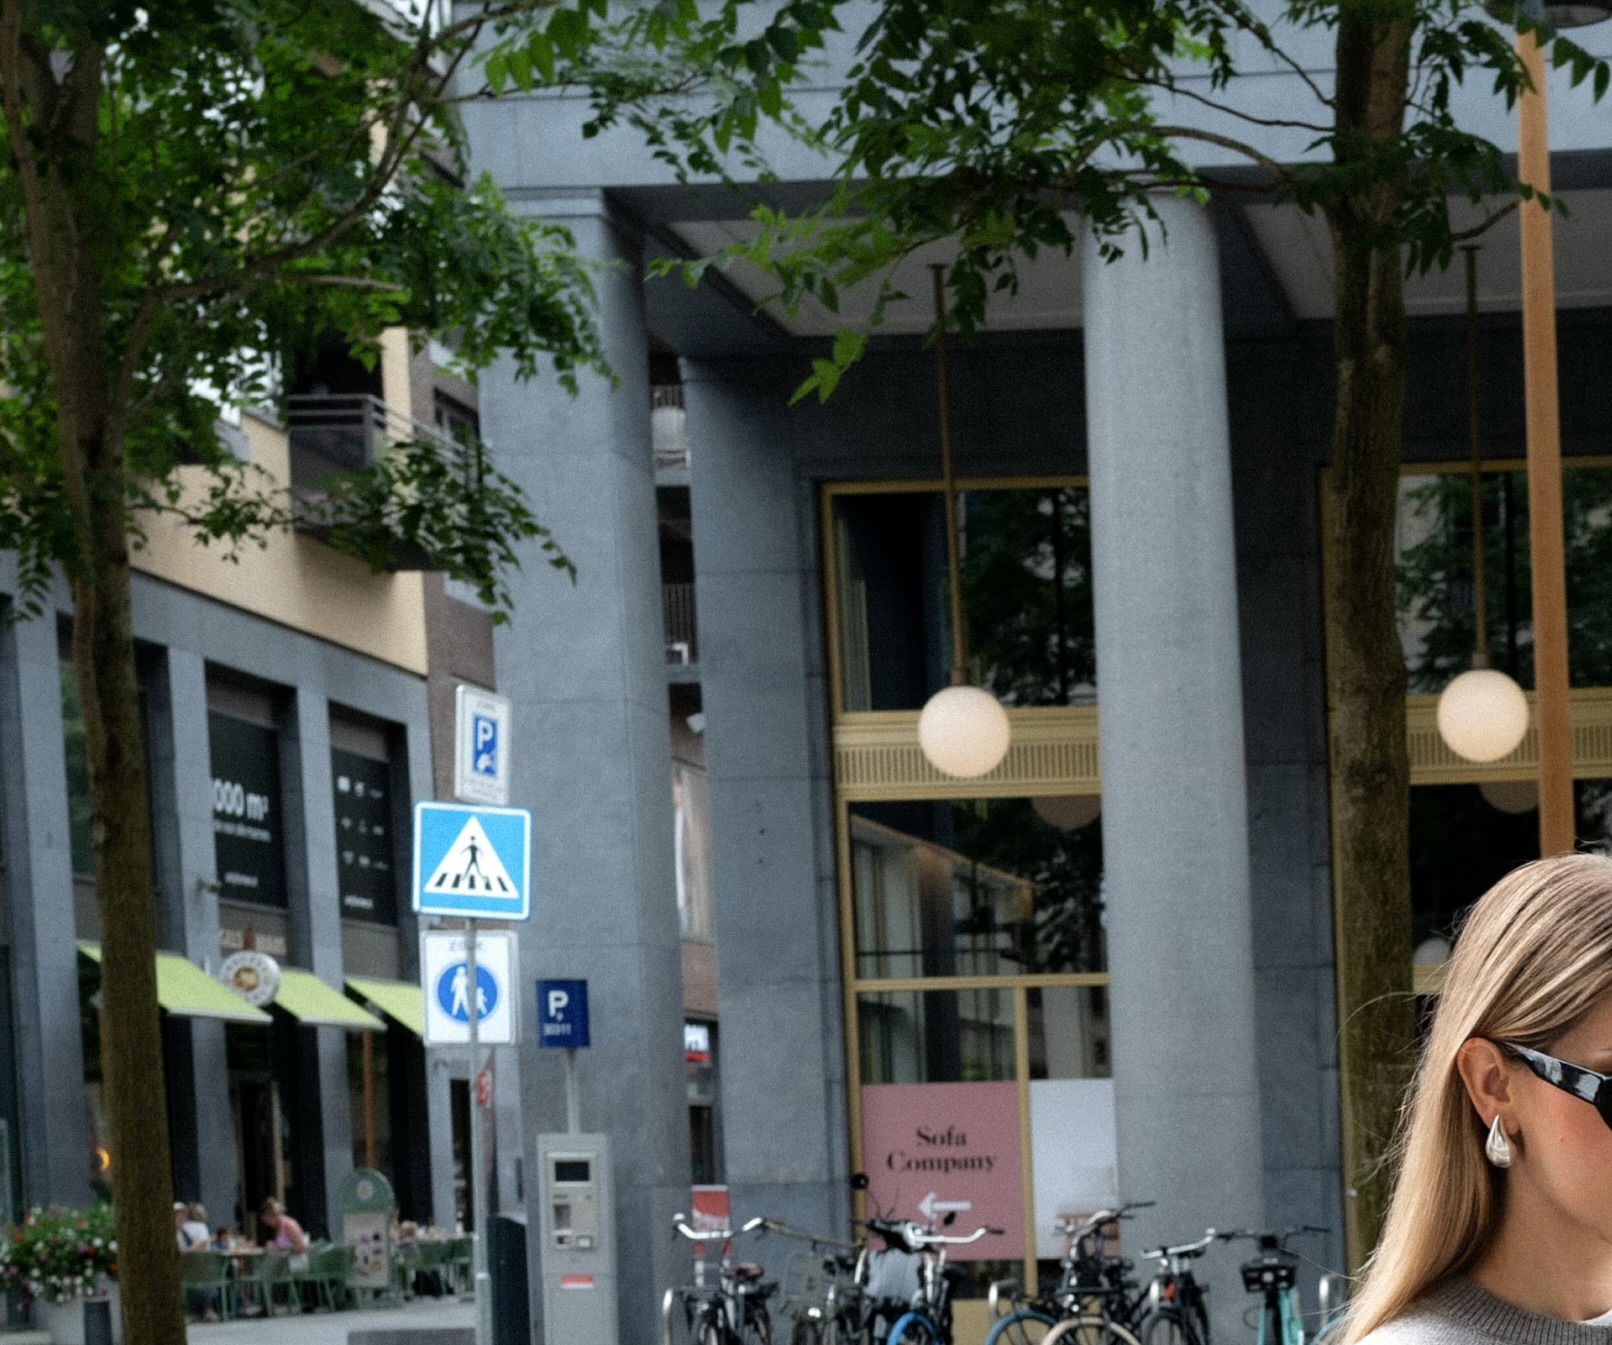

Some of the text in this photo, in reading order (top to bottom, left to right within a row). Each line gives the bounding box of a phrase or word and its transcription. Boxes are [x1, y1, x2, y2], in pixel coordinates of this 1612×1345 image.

[477, 719, 494, 751] P
[548, 989, 569, 1017] P
[915, 1125, 967, 1147] Sofa
[886, 1150, 996, 1174] Company
